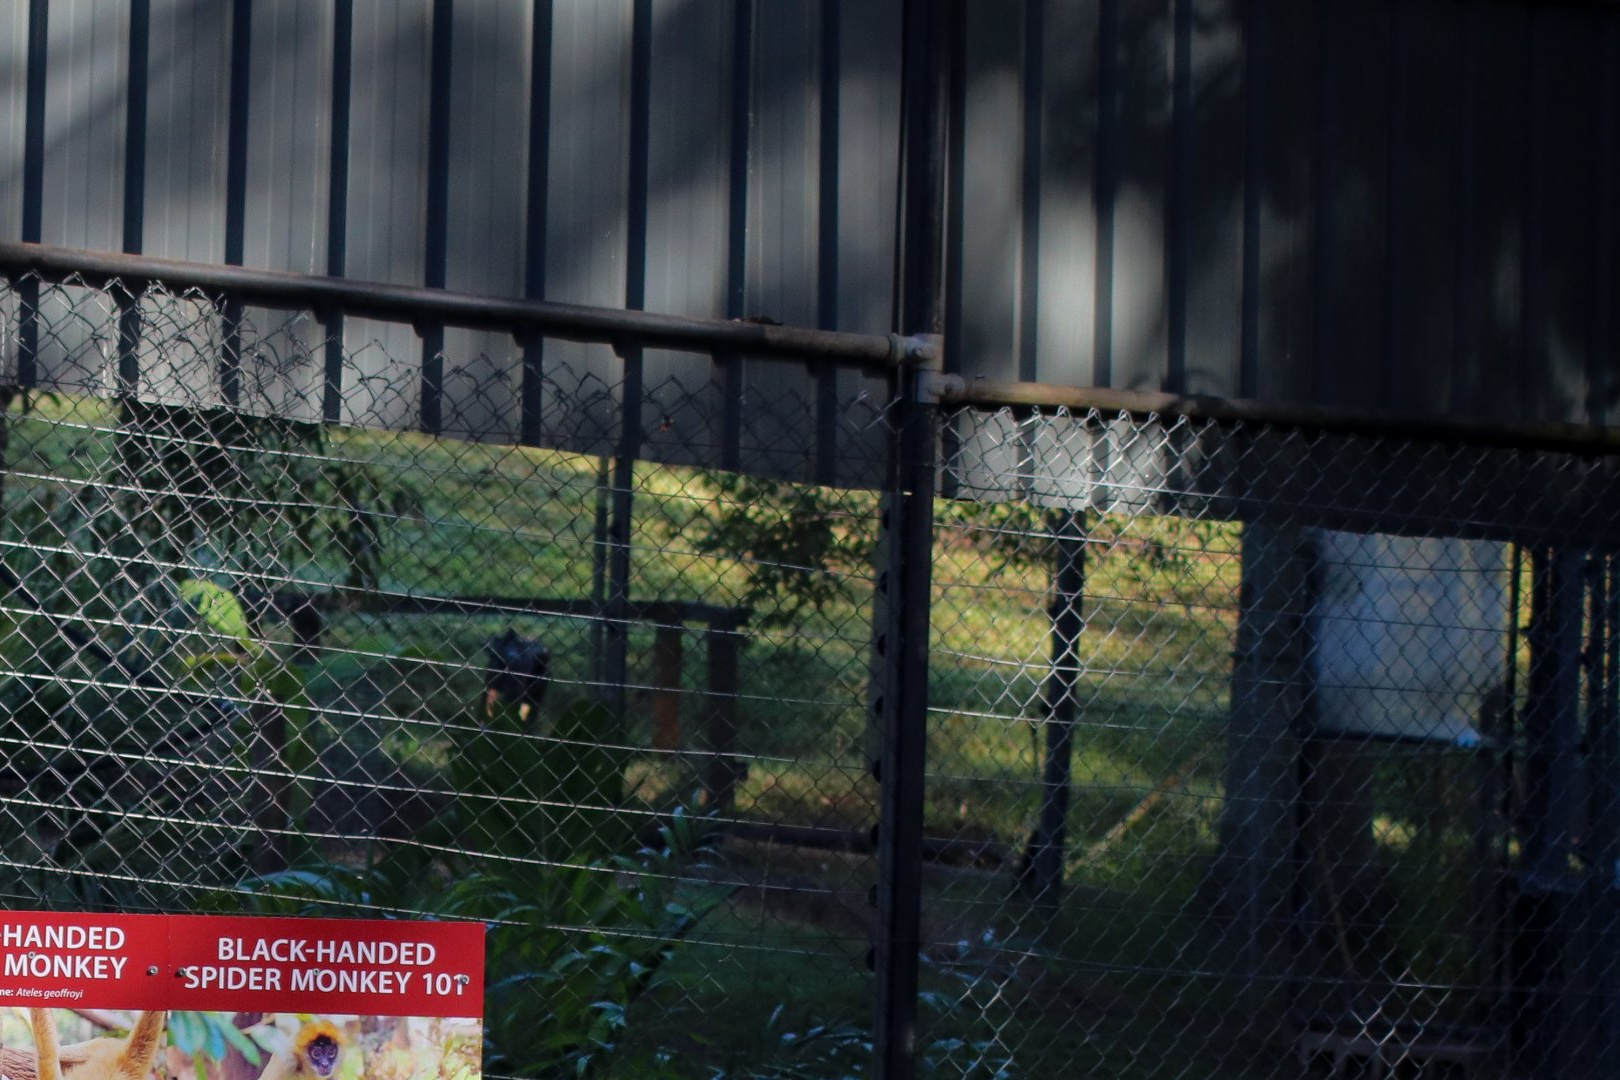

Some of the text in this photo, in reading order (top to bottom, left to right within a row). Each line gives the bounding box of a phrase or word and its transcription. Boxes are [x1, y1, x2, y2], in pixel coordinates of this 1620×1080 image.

[218, 938, 436, 966] BLACK-HANDED
[4, 953, 127, 979] MONKEY
[16, 988, 42, 997] Ateles
[44, 988, 83, 999] geoffroyi
[184, 966, 464, 996] SPIDER MONKEY 101
